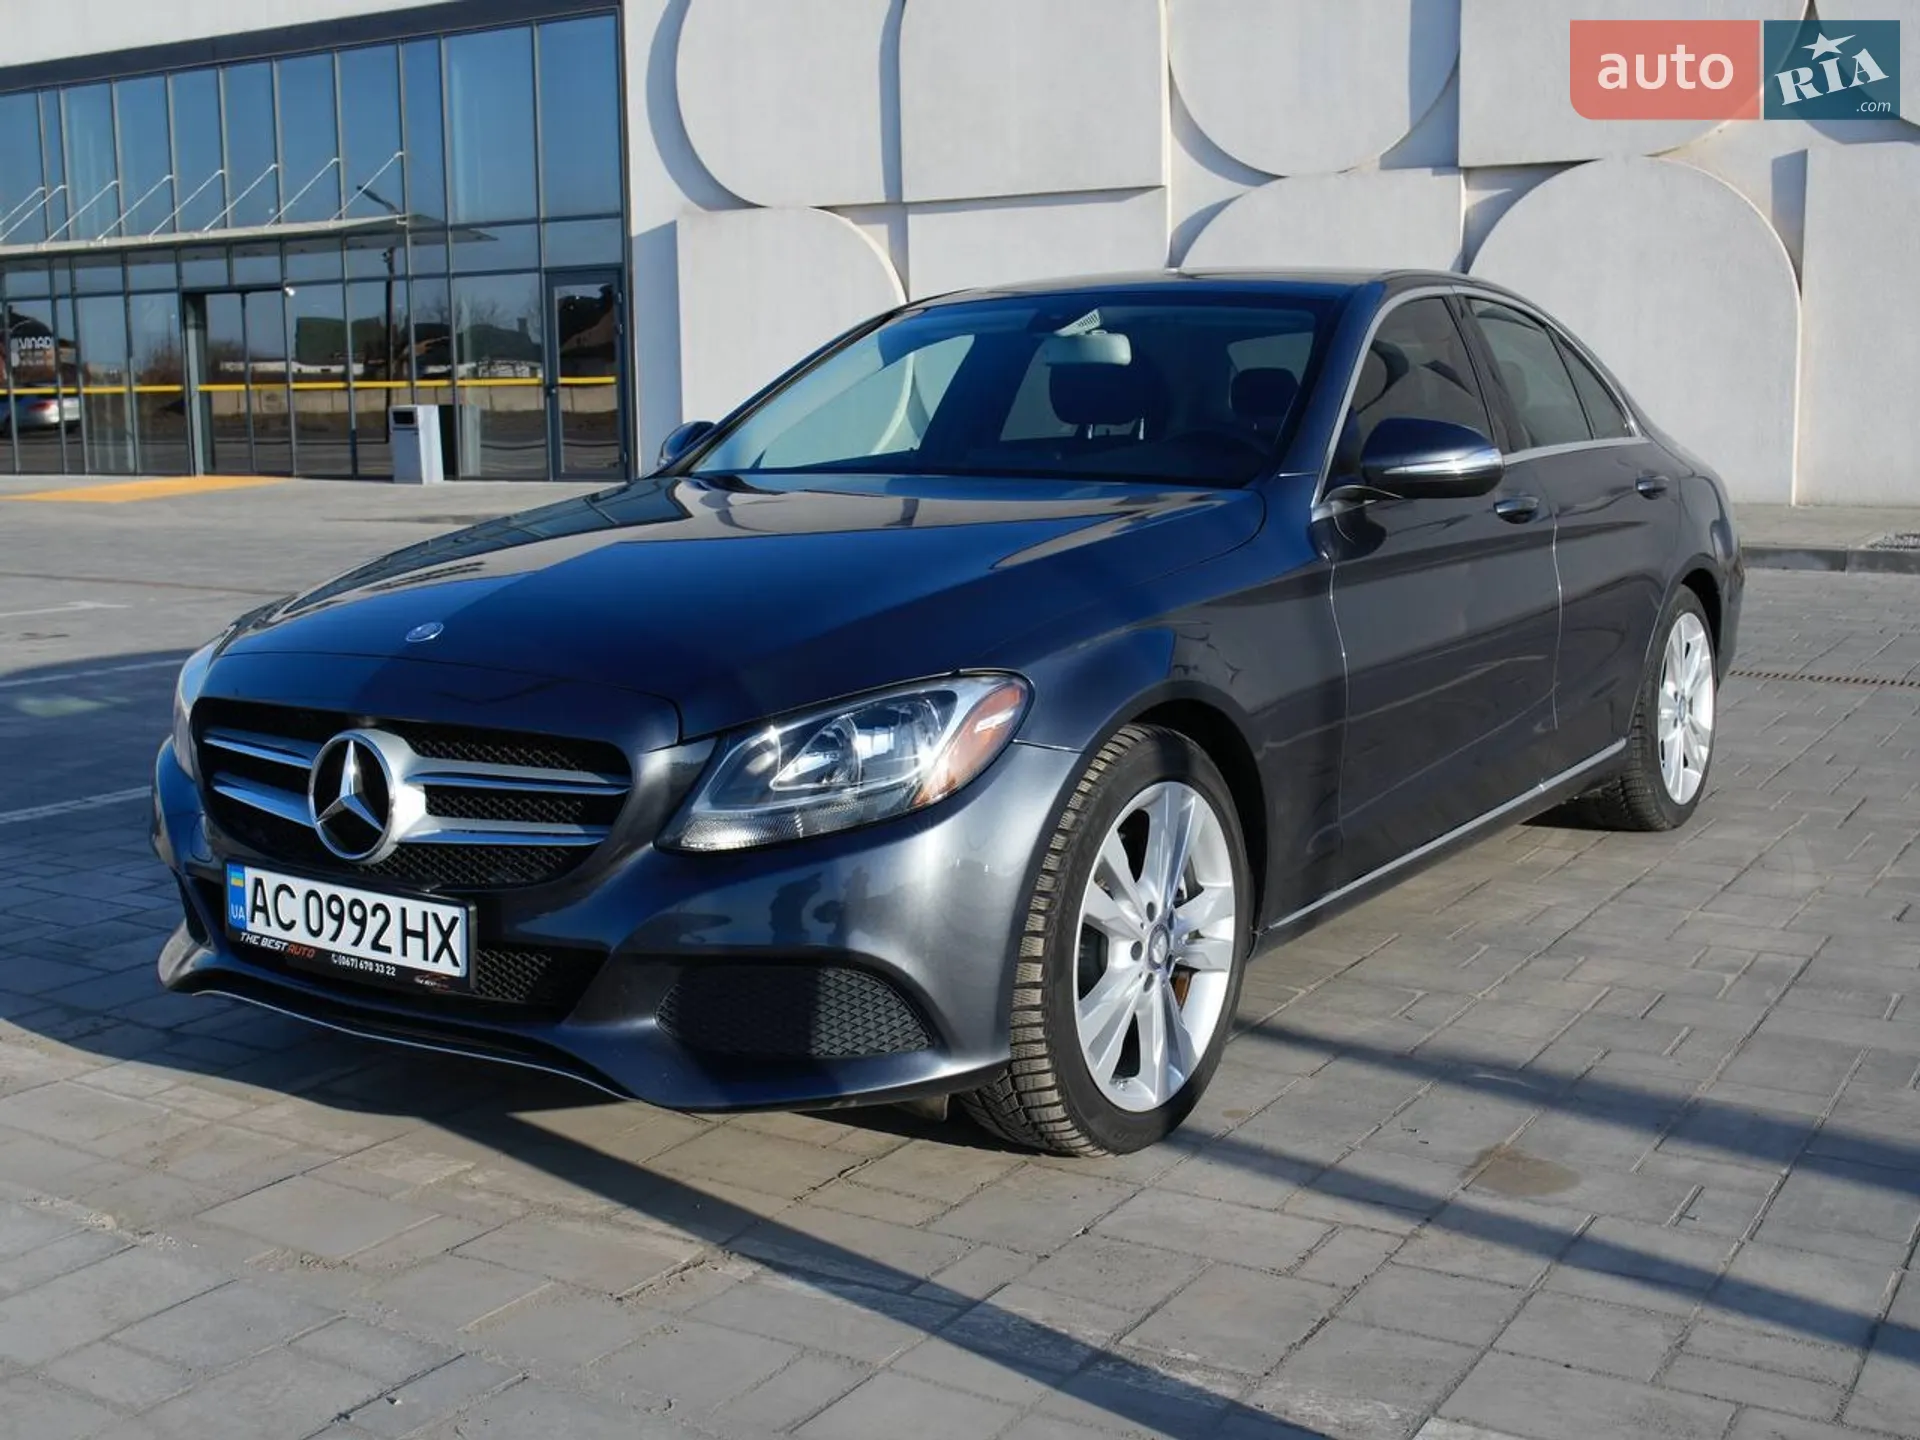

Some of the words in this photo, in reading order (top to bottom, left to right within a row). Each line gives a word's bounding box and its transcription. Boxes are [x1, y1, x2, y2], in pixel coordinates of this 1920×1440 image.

[231, 904, 246, 920] UA
[250, 876, 297, 931] AC
[304, 889, 392, 954] 0992
[400, 906, 460, 968] HX
[240, 931, 259, 945] THE
[260, 937, 289, 951] BEST
[288, 944, 316, 959] AUTO
[386, 966, 396, 976] 22
